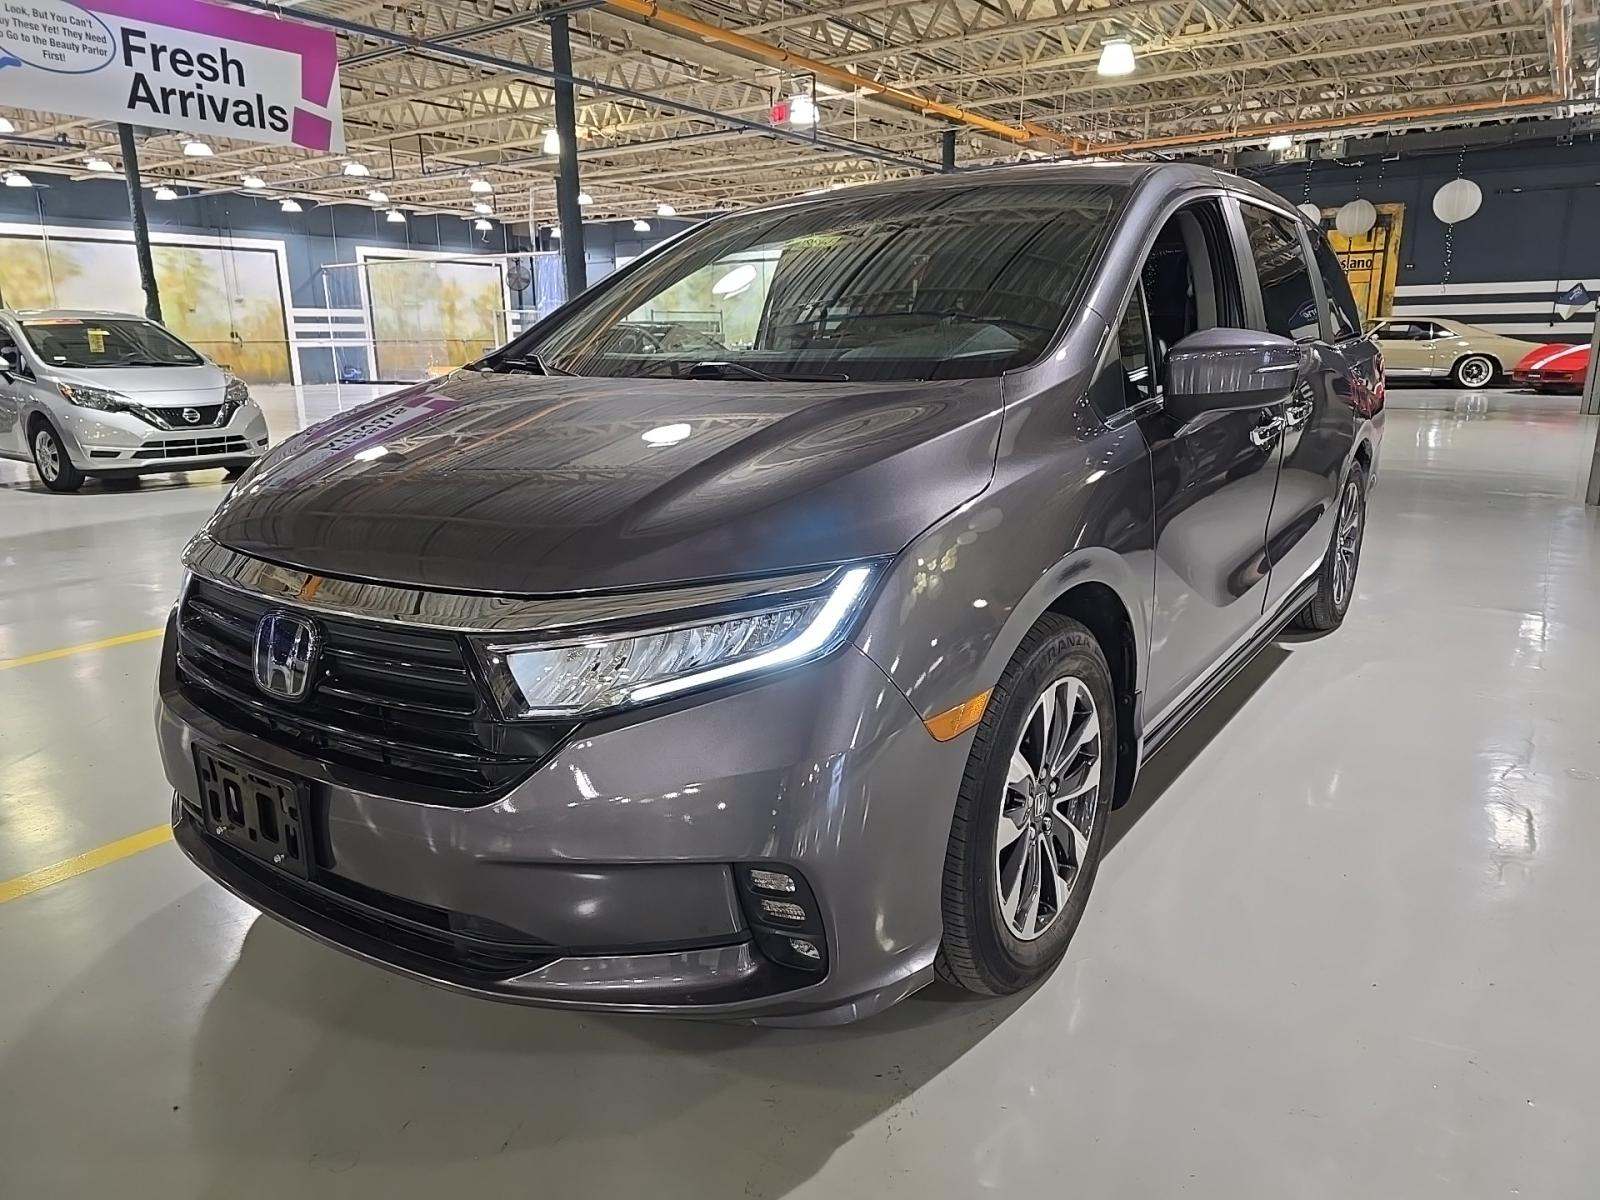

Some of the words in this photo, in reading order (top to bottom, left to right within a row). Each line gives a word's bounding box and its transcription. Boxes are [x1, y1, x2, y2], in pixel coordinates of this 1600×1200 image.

[5, 3, 30, 17] Look,
[32, 8, 48, 20] But
[50, 11, 67, 24] You
[70, 15, 92, 28] Can't
[6, 30, 18, 41] Go
[21, 32, 31, 42] to
[32, 34, 47, 46] the
[50, 37, 80, 53] Beauty
[82, 43, 107, 57] Parlor
[12, 17, 40, 31] These
[41, 23, 60, 34] Yet!
[62, 27, 82, 41] They
[85, 31, 107, 44] Need
[42, 49, 66, 62] First!
[120, 26, 246, 87] Fresh
[127, 72, 289, 132] Arrivals
